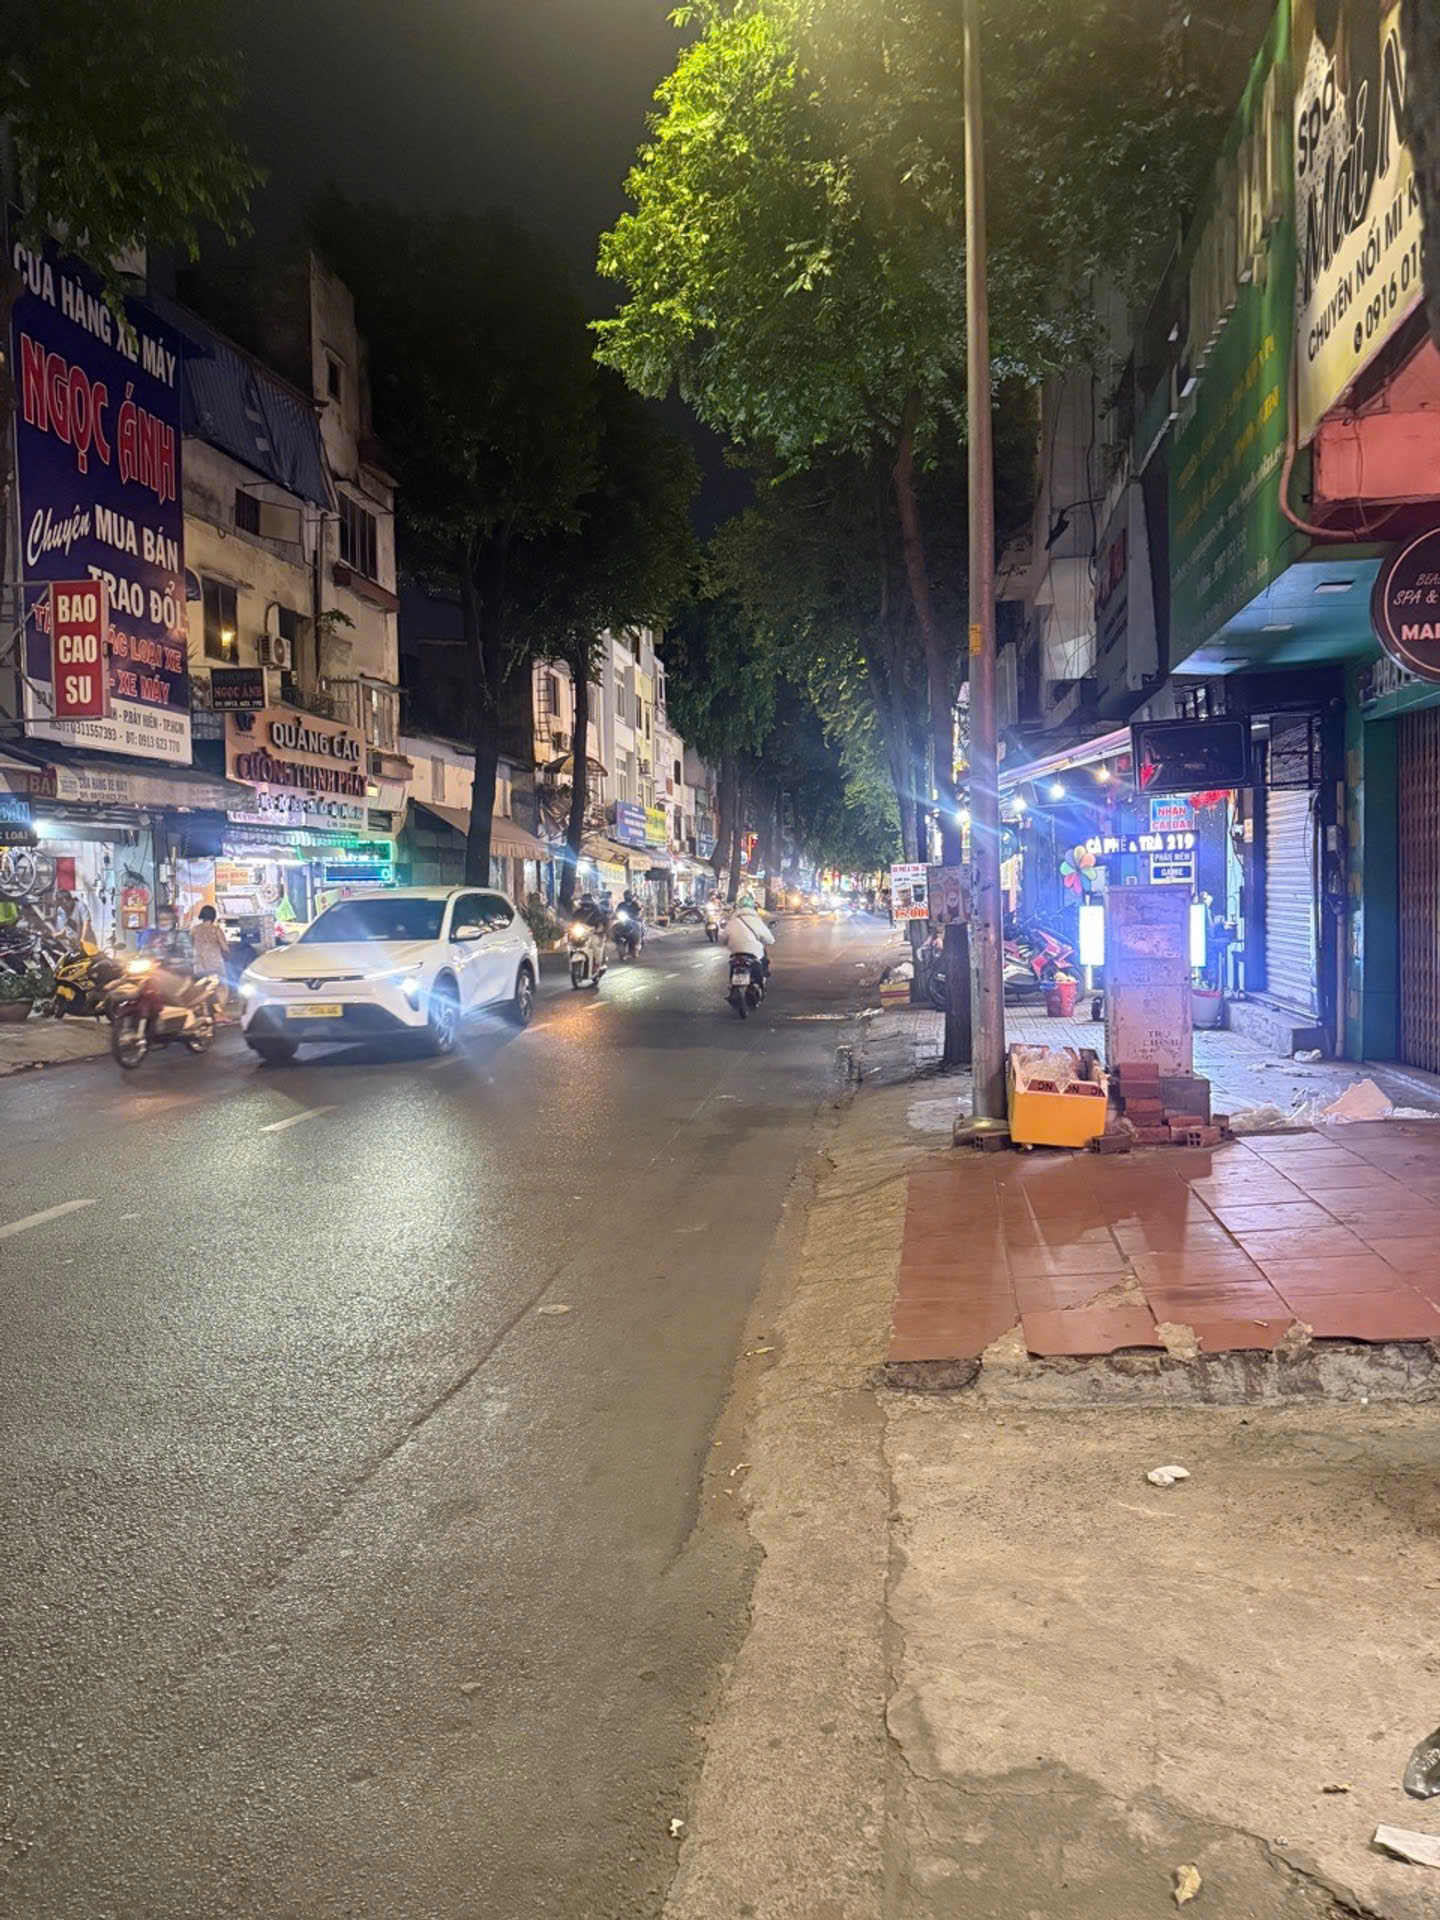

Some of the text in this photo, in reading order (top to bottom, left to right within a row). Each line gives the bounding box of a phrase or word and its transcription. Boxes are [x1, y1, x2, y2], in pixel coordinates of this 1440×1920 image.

[1307, 276, 1353, 362] CHUYÊN
[1356, 215, 1382, 294] NỐI
[1384, 192, 1403, 252] MI
[1365, 271, 1398, 340] 0916
[61, 275, 112, 348] HÀNG
[142, 335, 176, 389] MÁY
[20, 332, 176, 505] NGỌC ÁNH
[26, 503, 179, 574] Chuyên MUA BÁN
[57, 593, 97, 624] BAO
[87, 564, 144, 618] TRAO
[1393, 589, 1422, 606] SPA
[58, 634, 98, 665] CAO
[164, 646, 182, 674] XE
[65, 674, 92, 705] SU
[117, 669, 171, 705] XE MÁY
[271, 717, 360, 761] QUẢNG CÁO
[1138, 832, 1164, 852] TRÀ
[1167, 832, 1195, 851] 219
